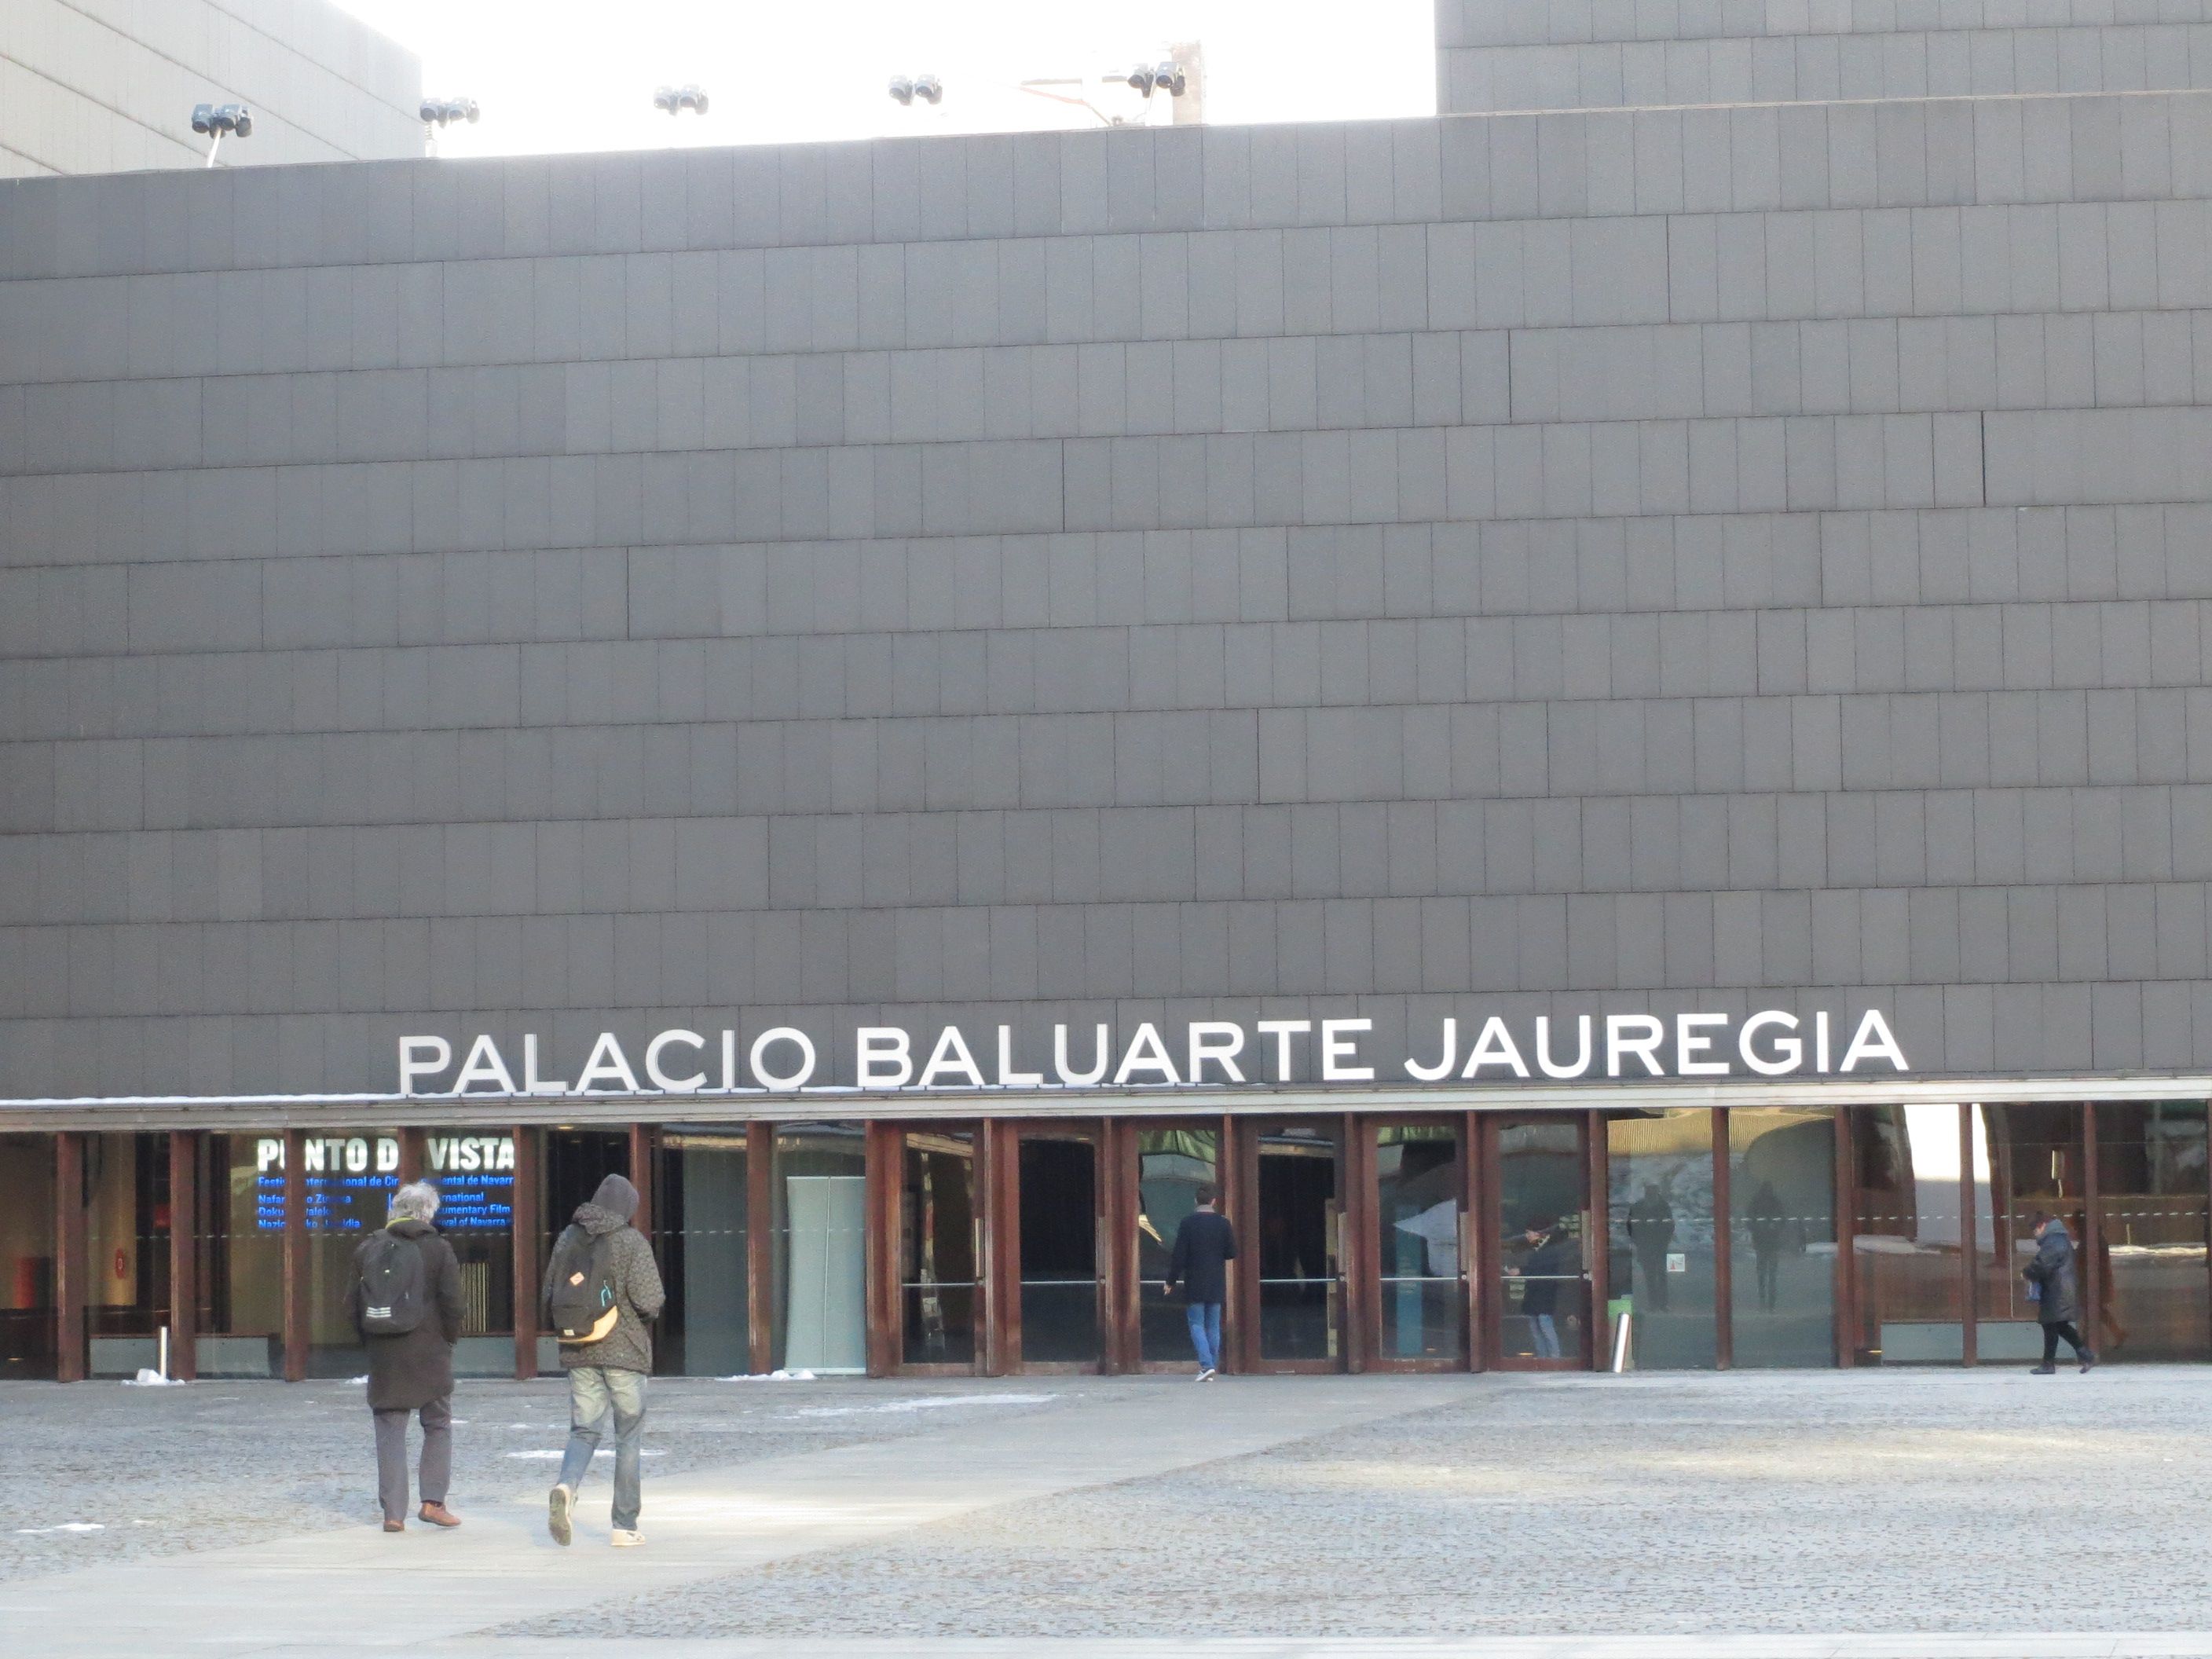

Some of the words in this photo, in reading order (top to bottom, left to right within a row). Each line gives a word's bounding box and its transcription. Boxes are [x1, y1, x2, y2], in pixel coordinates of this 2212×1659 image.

[400, 1027, 816, 1094] PALACIO
[856, 1018, 1375, 1088] BALUARTE
[1404, 1009, 1910, 1081] JAUREGIA
[258, 1137, 368, 1172] PNTO
[377, 1137, 399, 1171] D
[427, 1137, 515, 1170] VISTA
[369, 1176, 382, 1187] de
[467, 1175, 478, 1185] de
[481, 1174, 514, 1185] Navarr
[441, 1204, 487, 1215] umentary
[489, 1204, 511, 1214] Film
[459, 1217, 467, 1226] of
[470, 1216, 506, 1226] Navarra
